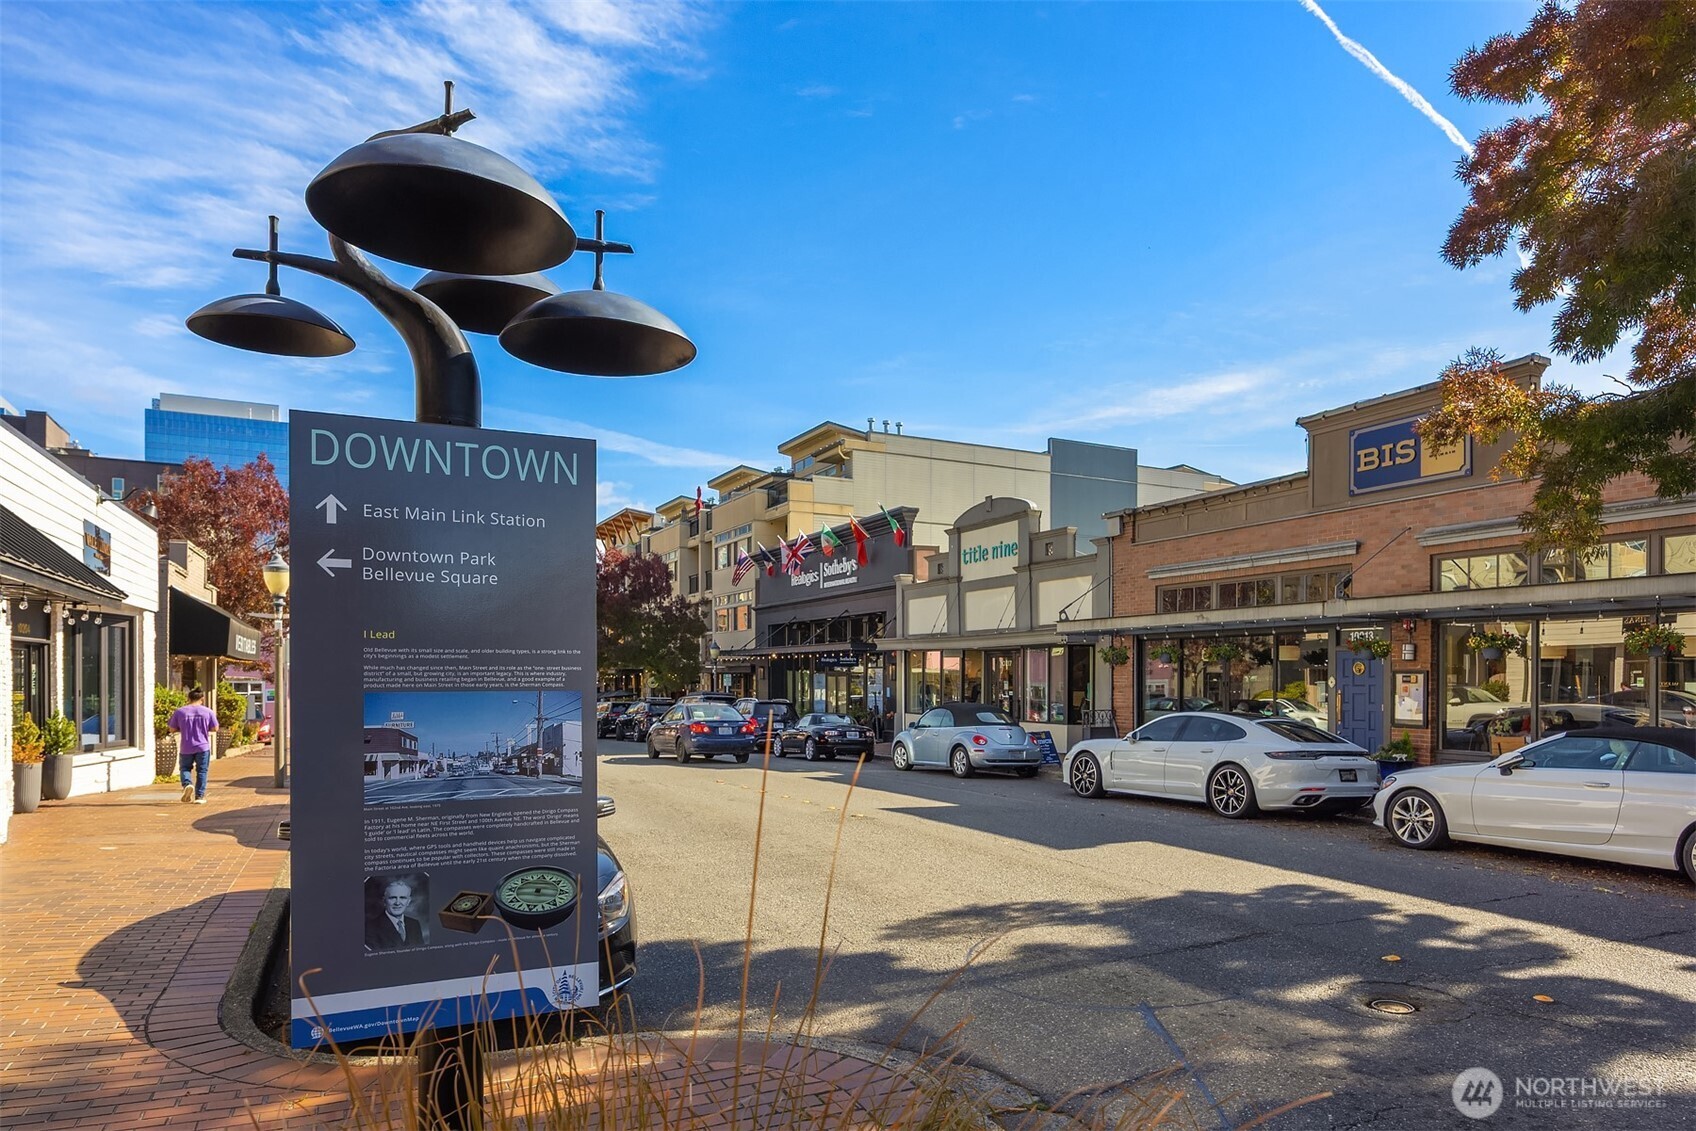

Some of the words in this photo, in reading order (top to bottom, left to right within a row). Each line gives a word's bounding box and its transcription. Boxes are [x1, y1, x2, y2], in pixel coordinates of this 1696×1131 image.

[311, 428, 578, 486] DOWNTOWN
[1356, 438, 1416, 472] BIS
[363, 504, 399, 519] East
[405, 506, 446, 522] Main
[452, 509, 485, 524] Link
[490, 512, 545, 528] Station
[362, 547, 454, 564] Downtown
[460, 552, 496, 566] Park
[962, 544, 989, 565] title
[992, 541, 1018, 560] nine
[362, 567, 435, 583] Bellevue
[441, 570, 498, 587] Square
[824, 557, 858, 576] Sotheby's
[363, 630, 366, 638] I
[370, 630, 395, 639] Lead
